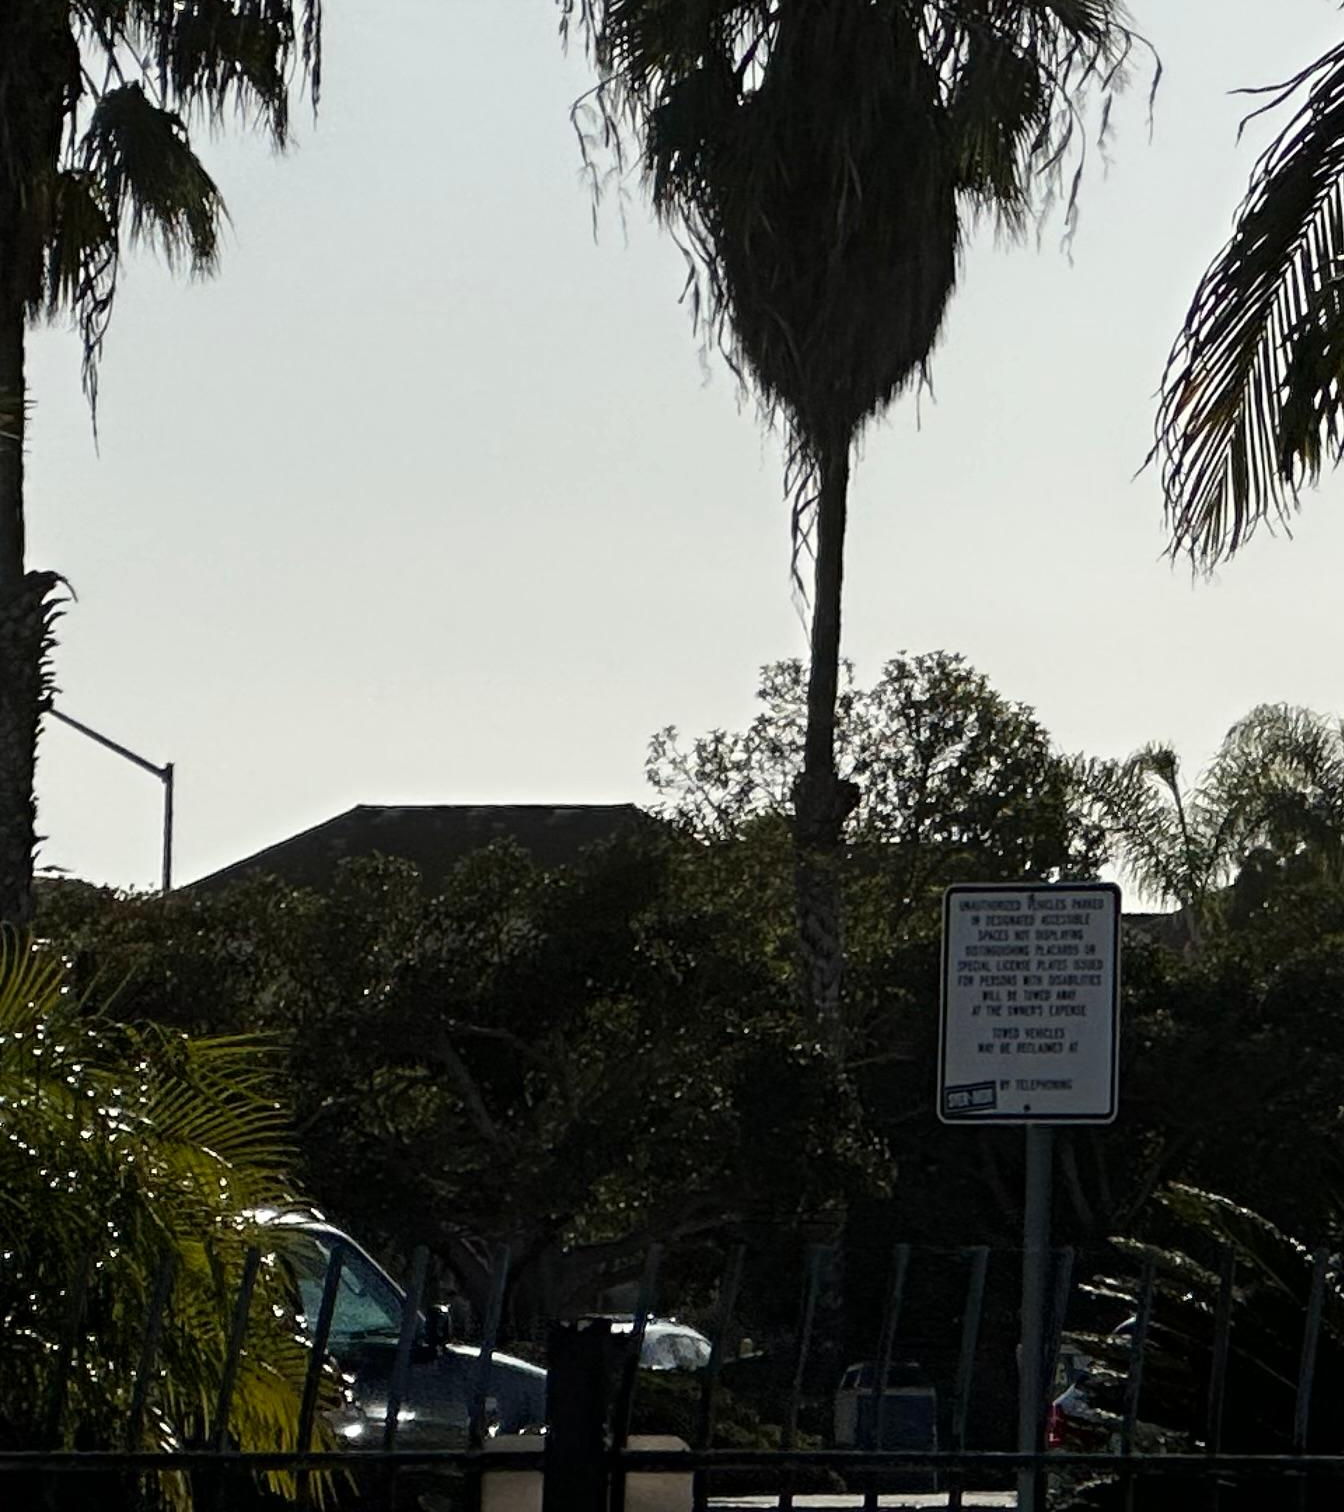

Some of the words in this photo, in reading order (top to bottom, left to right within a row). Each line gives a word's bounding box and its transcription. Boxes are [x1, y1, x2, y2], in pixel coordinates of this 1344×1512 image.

[959, 900, 1021, 911] UNAUTHORIZED
[1028, 899, 1066, 910] VEHICLES
[1072, 898, 1104, 909] PARKED
[971, 915, 981, 926] IN
[986, 914, 1034, 925] DESIGNATED
[1041, 913, 1089, 925] ACCESSIBLE
[977, 930, 1009, 941] SPACES
[1014, 930, 1030, 940] NOT
[1035, 929, 1084, 940] DISPLAYING
[965, 945, 1029, 956] DISTINGUISHING
[1035, 945, 1079, 955] PLACARDS
[1085, 944, 1096, 955] OR
[957, 961, 990, 972] SPECIAL
[996, 960, 1030, 971] LICENSE
[1037, 960, 1067, 970] PLATES
[1073, 960, 1103, 970] ISSUED
[957, 975, 973, 986] FOR
[980, 975, 1017, 986] PERSONS
[1023, 975, 1042, 985] WITH
[1048, 974, 1102, 985] DISABILITIES
[982, 991, 1001, 1001] WILL
[1007, 990, 1017, 1001] BE
[1023, 990, 1051, 1001] TOWED
[1056, 990, 1077, 1001] AWAY
[971, 1005, 982, 1017] AT
[986, 1005, 1001, 1016] THE
[1008, 1005, 1043, 1017] OWNER'S
[1049, 1005, 1087, 1016] EXPENSE
[992, 1028, 1020, 1039] TOWED
[1025, 1027, 1065, 1039] VEHICLES
[977, 1043, 993, 1054] MAY
[1000, 1043, 1011, 1055] BE
[1016, 1043, 1063, 1054] RECLAIMED
[1069, 1042, 1079, 1053] AT
[1000, 1080, 1012, 1091] BY
[1015, 1079, 1073, 1090] TELEPHONING
